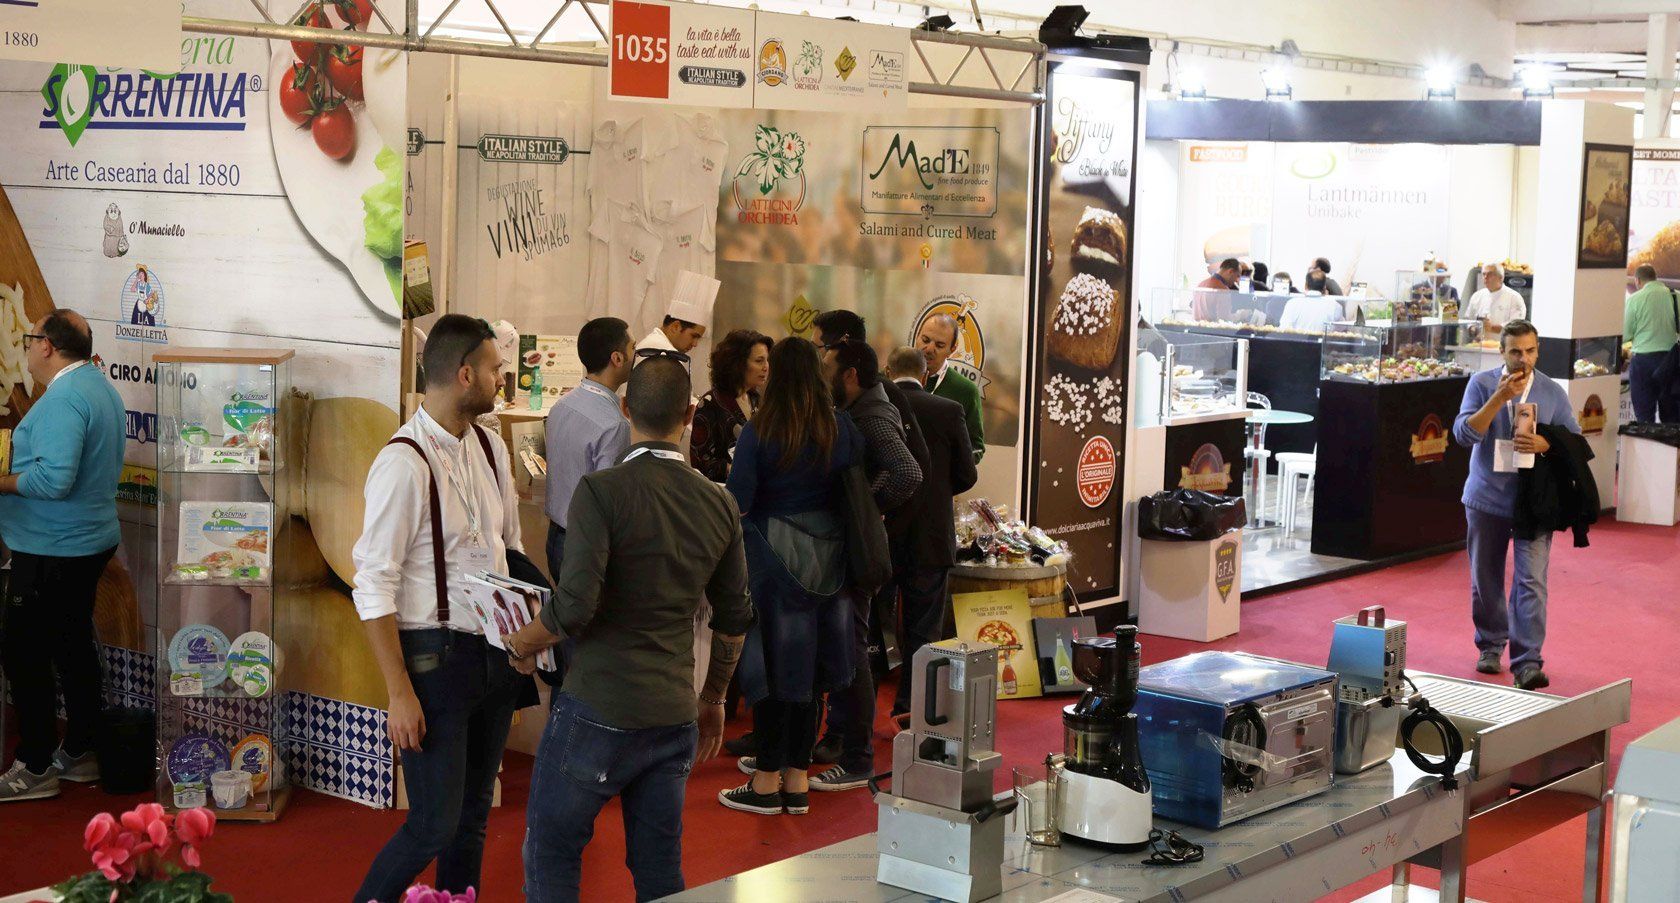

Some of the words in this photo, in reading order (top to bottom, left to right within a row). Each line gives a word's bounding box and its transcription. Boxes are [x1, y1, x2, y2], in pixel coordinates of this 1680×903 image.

[4, 31, 39, 47] 1880
[687, 26, 696, 41] la
[698, 28, 712, 41] vita
[721, 27, 741, 42] bella
[615, 33, 667, 64] 1035
[677, 42, 699, 58] taste
[701, 43, 717, 58] eat
[718, 42, 737, 59] with
[739, 46, 751, 59] us
[687, 67, 715, 78] ITALIAN
[716, 70, 739, 80] STYLE
[795, 83, 820, 91] ORCHIDEA
[484, 137, 527, 152] ITALIAN
[528, 140, 563, 153] STYLE
[487, 150, 526, 160] NEAPOLITAN
[528, 152, 560, 161] TRADITION
[45, 159, 79, 181] Arte
[84, 160, 157, 184] Casearia
[163, 162, 190, 185] dal
[199, 163, 240, 187] 1880
[972, 162, 990, 175] 1849
[487, 179, 537, 202] DEGUSTAZIONE
[964, 178, 989, 187] produce
[872, 190, 908, 200] Manifatture
[910, 191, 943, 201] Alimentari
[945, 192, 986, 202] d'Eccellenza
[1307, 185, 1428, 204] Lantmännen
[504, 189, 545, 222] WINE
[744, 198, 792, 212] LATTICINI
[1307, 203, 1362, 218] Unibake
[738, 212, 799, 226] ORCHIDEA
[487, 211, 536, 259] VINI
[860, 222, 898, 236] Salami
[901, 224, 923, 238] and
[926, 225, 962, 239] Cured
[965, 227, 997, 241] Meat
[116, 324, 168, 341] DONZELLETTA
[110, 363, 141, 383] CIRO
